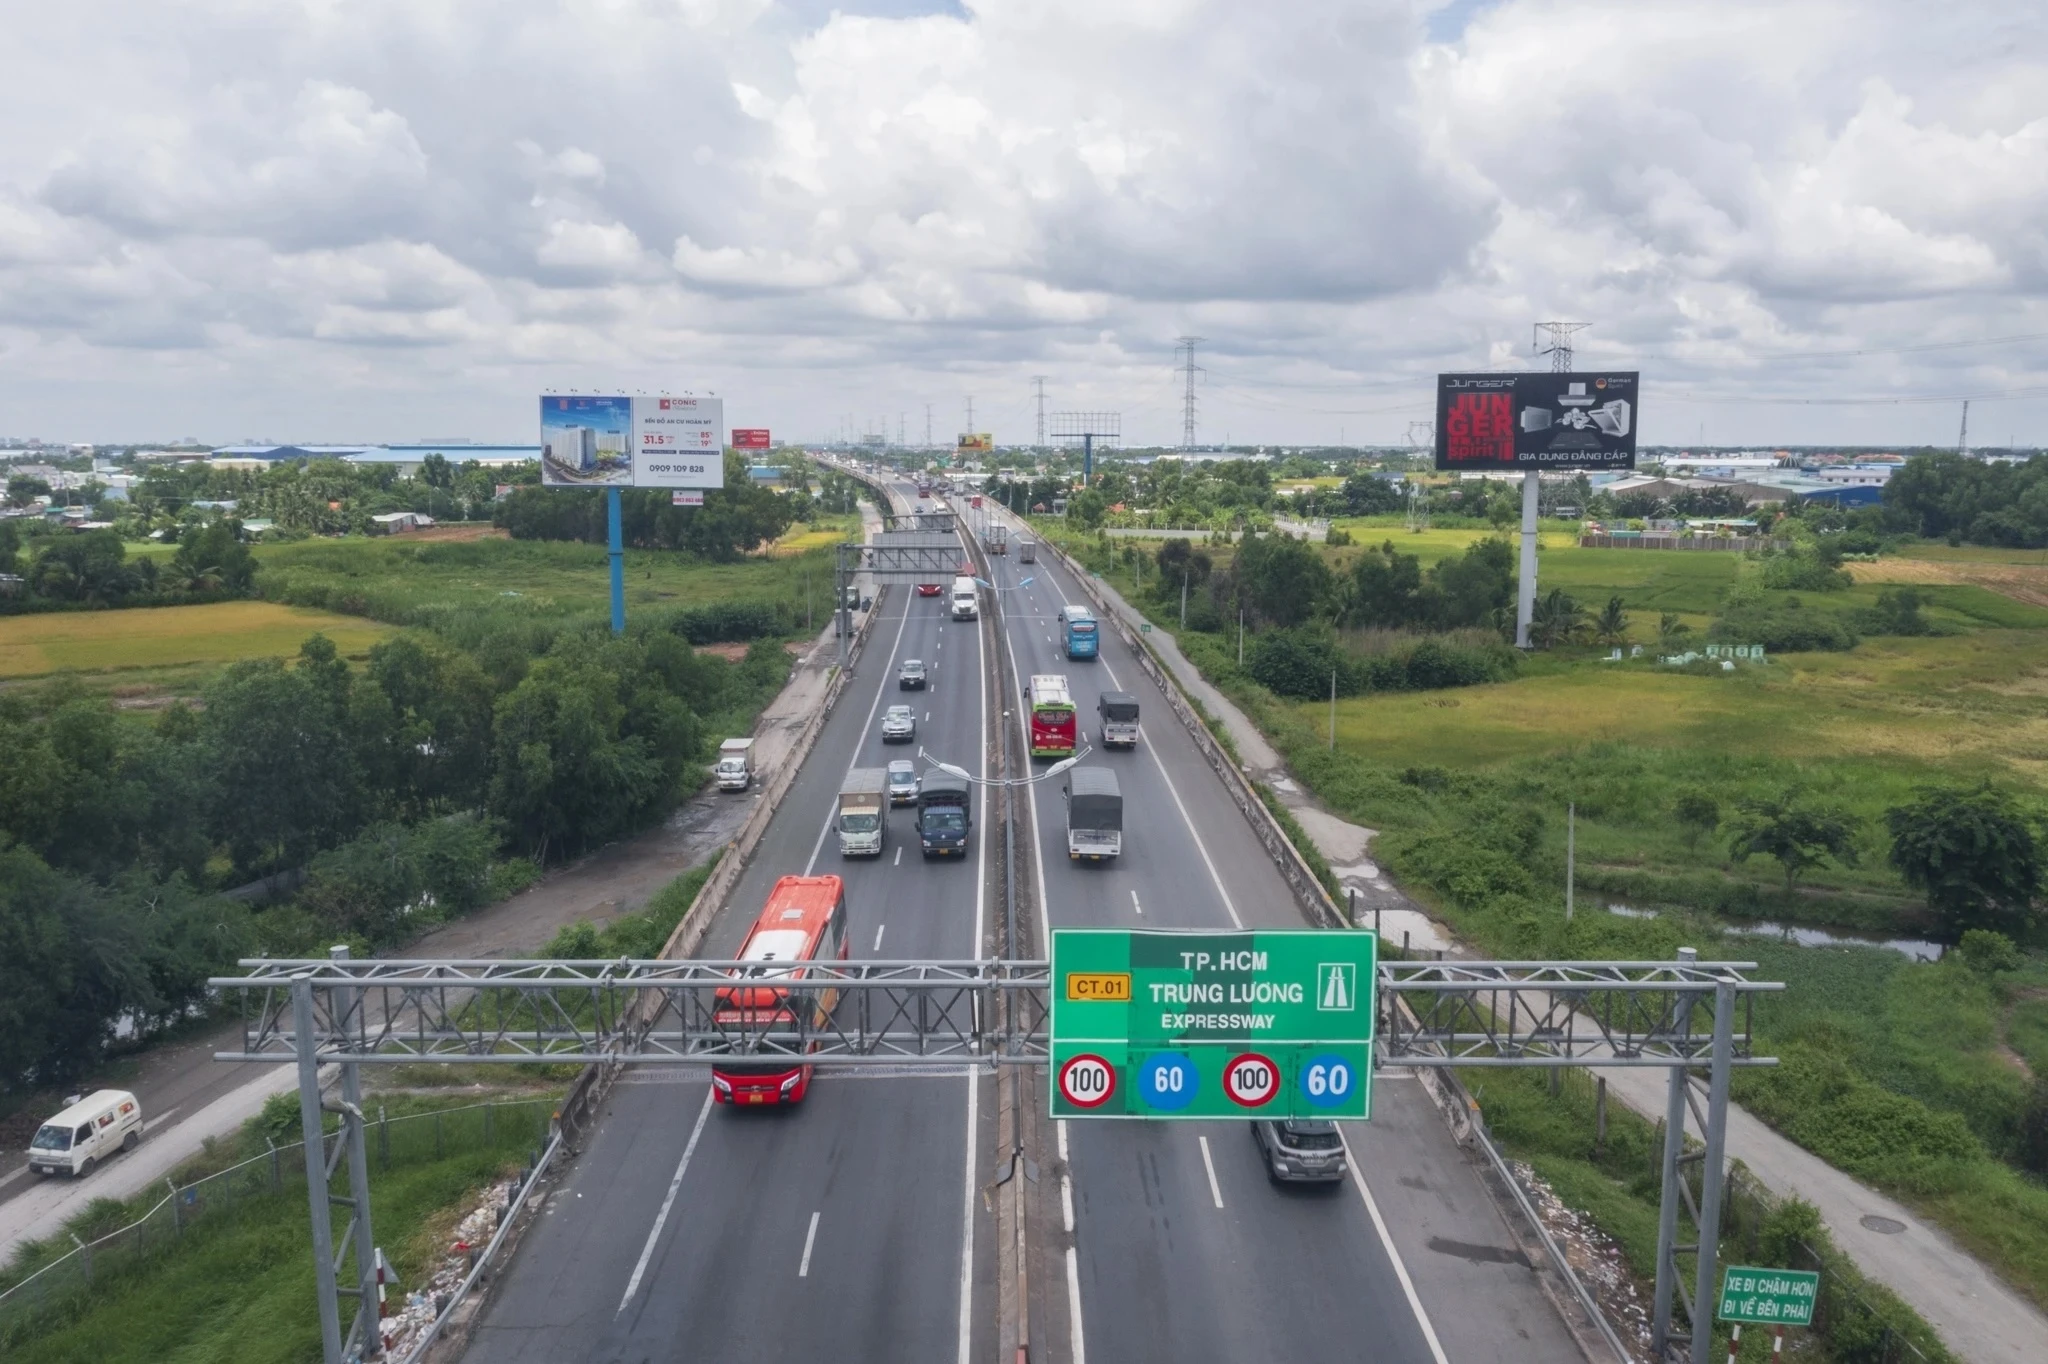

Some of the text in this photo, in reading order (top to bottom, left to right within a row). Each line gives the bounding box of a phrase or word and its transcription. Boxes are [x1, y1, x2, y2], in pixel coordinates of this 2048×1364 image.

[1447, 415, 1513, 437] GER
[643, 435, 664, 445] 31.5
[1518, 453, 1536, 461] GIA
[1538, 453, 1569, 462] DỤNG
[1603, 449, 1628, 460] CẤP
[689, 465, 704, 473] 828
[1180, 951, 1268, 971] TP.HCM
[1077, 980, 1122, 995] CT.01
[1149, 981, 1303, 1003] TRUNG LƯƠNG
[1161, 1013, 1276, 1030] EXPRESSWAY
[1070, 1067, 1105, 1092] 100
[1155, 1067, 1183, 1092] 60
[1234, 1067, 1269, 1090] 100
[1308, 1064, 1348, 1096] 60
[1727, 1276, 1814, 1297] XE ĐI CHẬM HƠN
[1724, 1296, 1809, 1319] ĐI VỀ BÊN PHẢI
